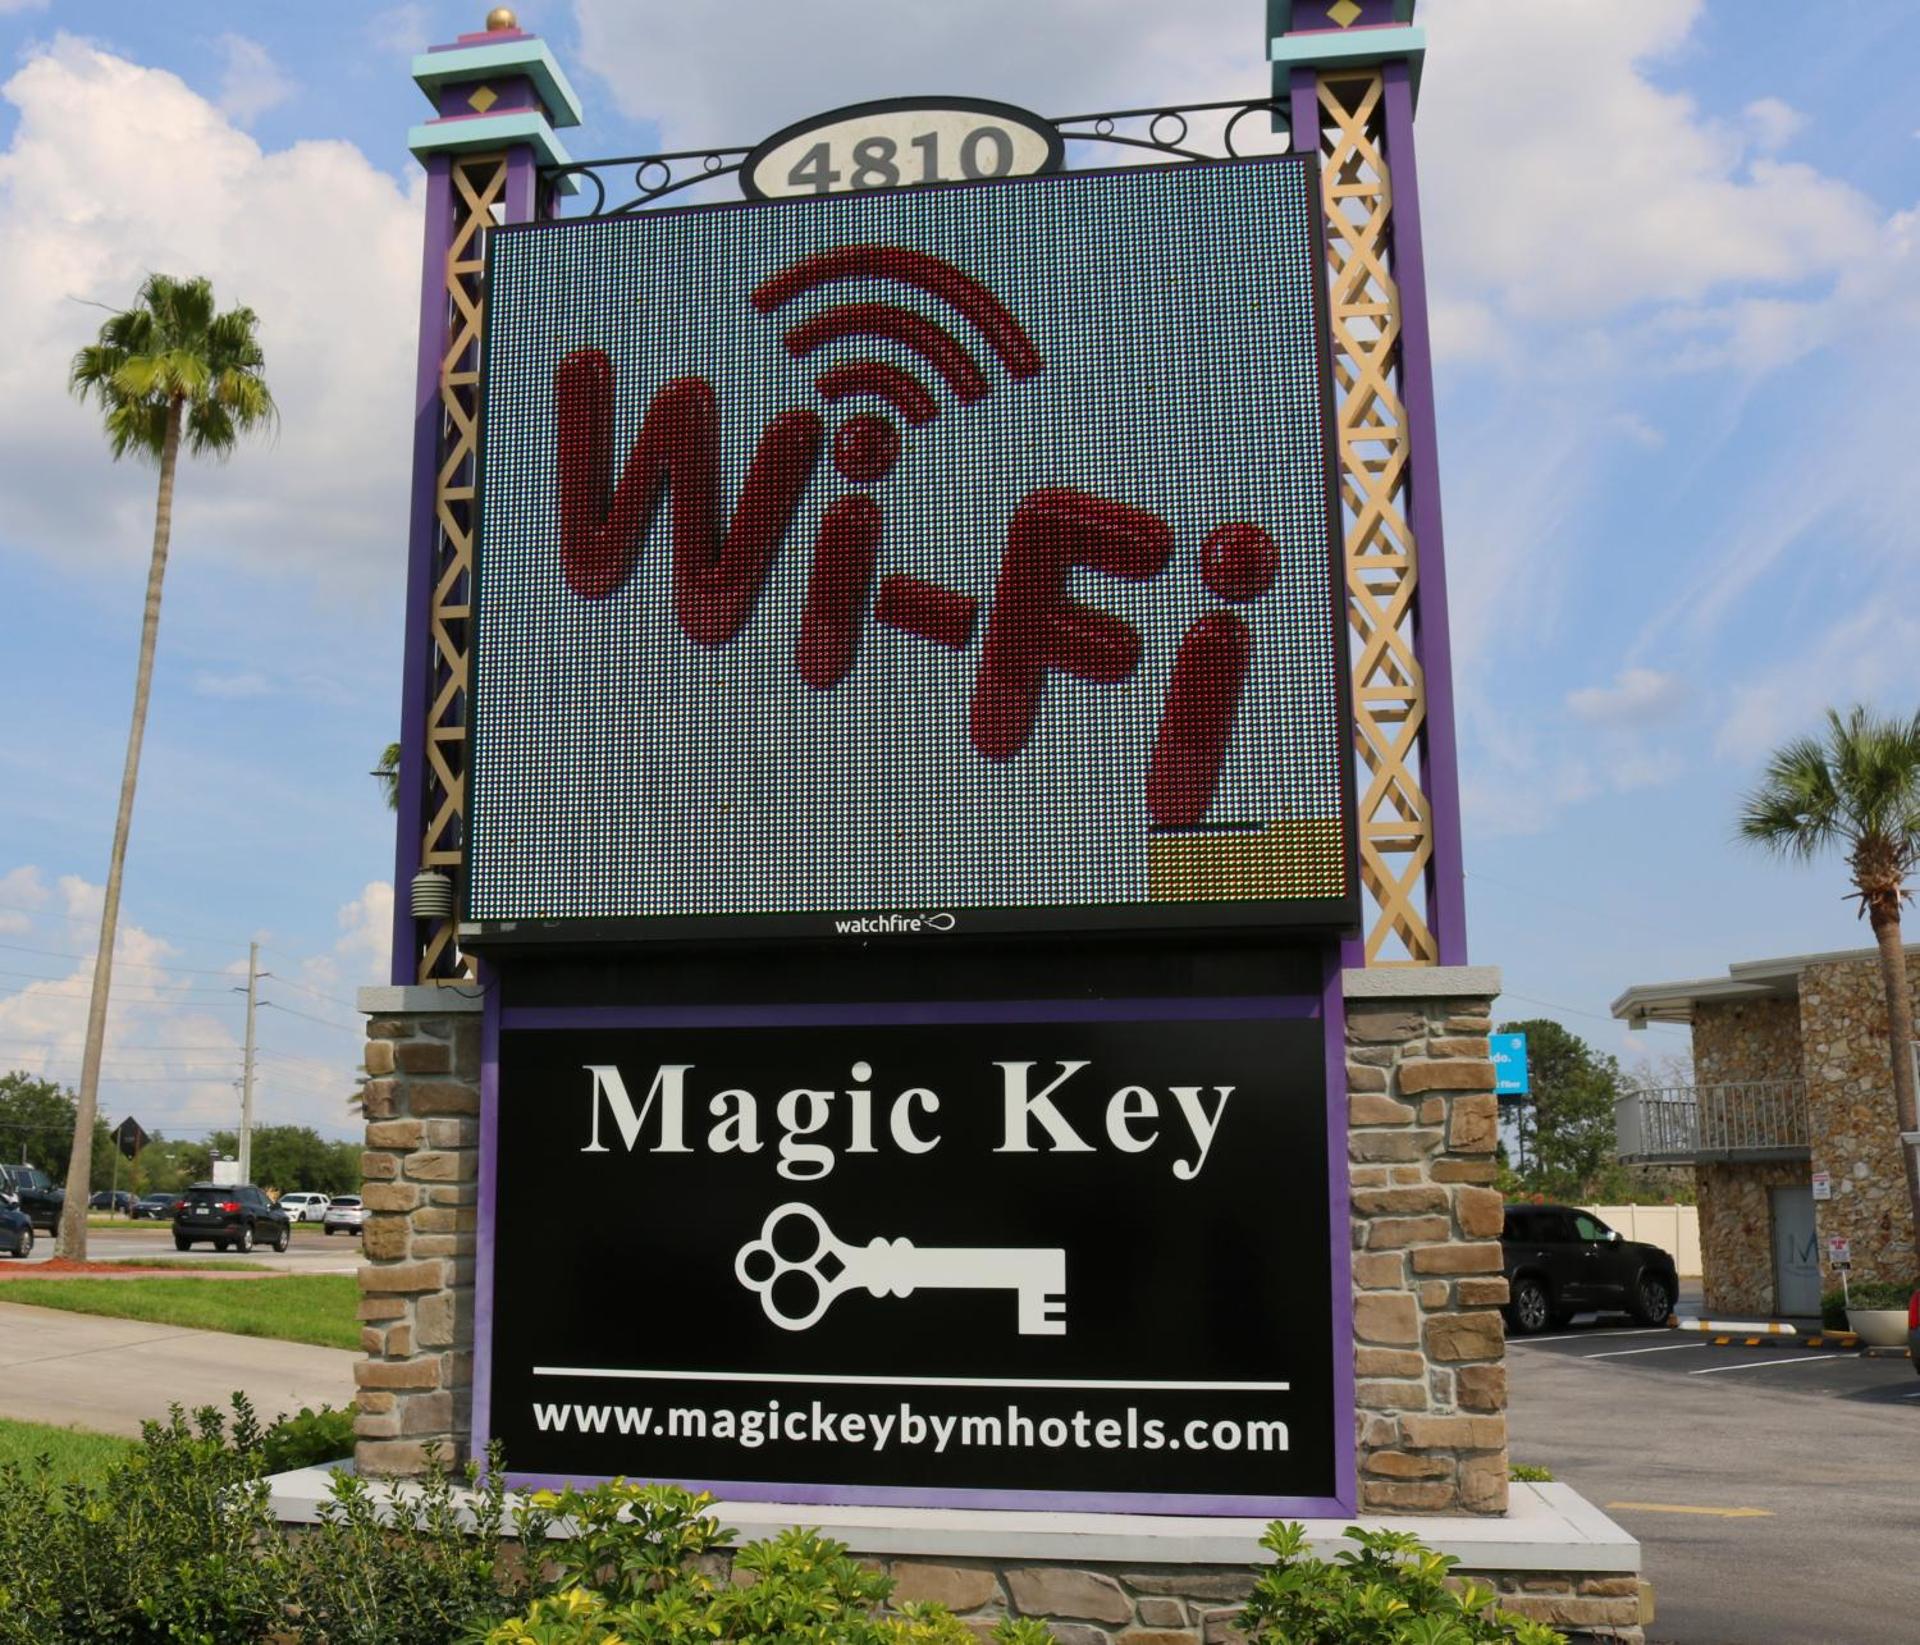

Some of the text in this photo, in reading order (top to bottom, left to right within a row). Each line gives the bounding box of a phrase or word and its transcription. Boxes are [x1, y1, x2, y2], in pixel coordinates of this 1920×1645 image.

[787, 126, 1014, 194] 4810
[553, 348, 1280, 828] Wi-Fi
[835, 914, 921, 933] watchfire
[581, 1060, 1236, 1181] Magic Key
[532, 1399, 1290, 1453] www.magickeybymhotels.com
